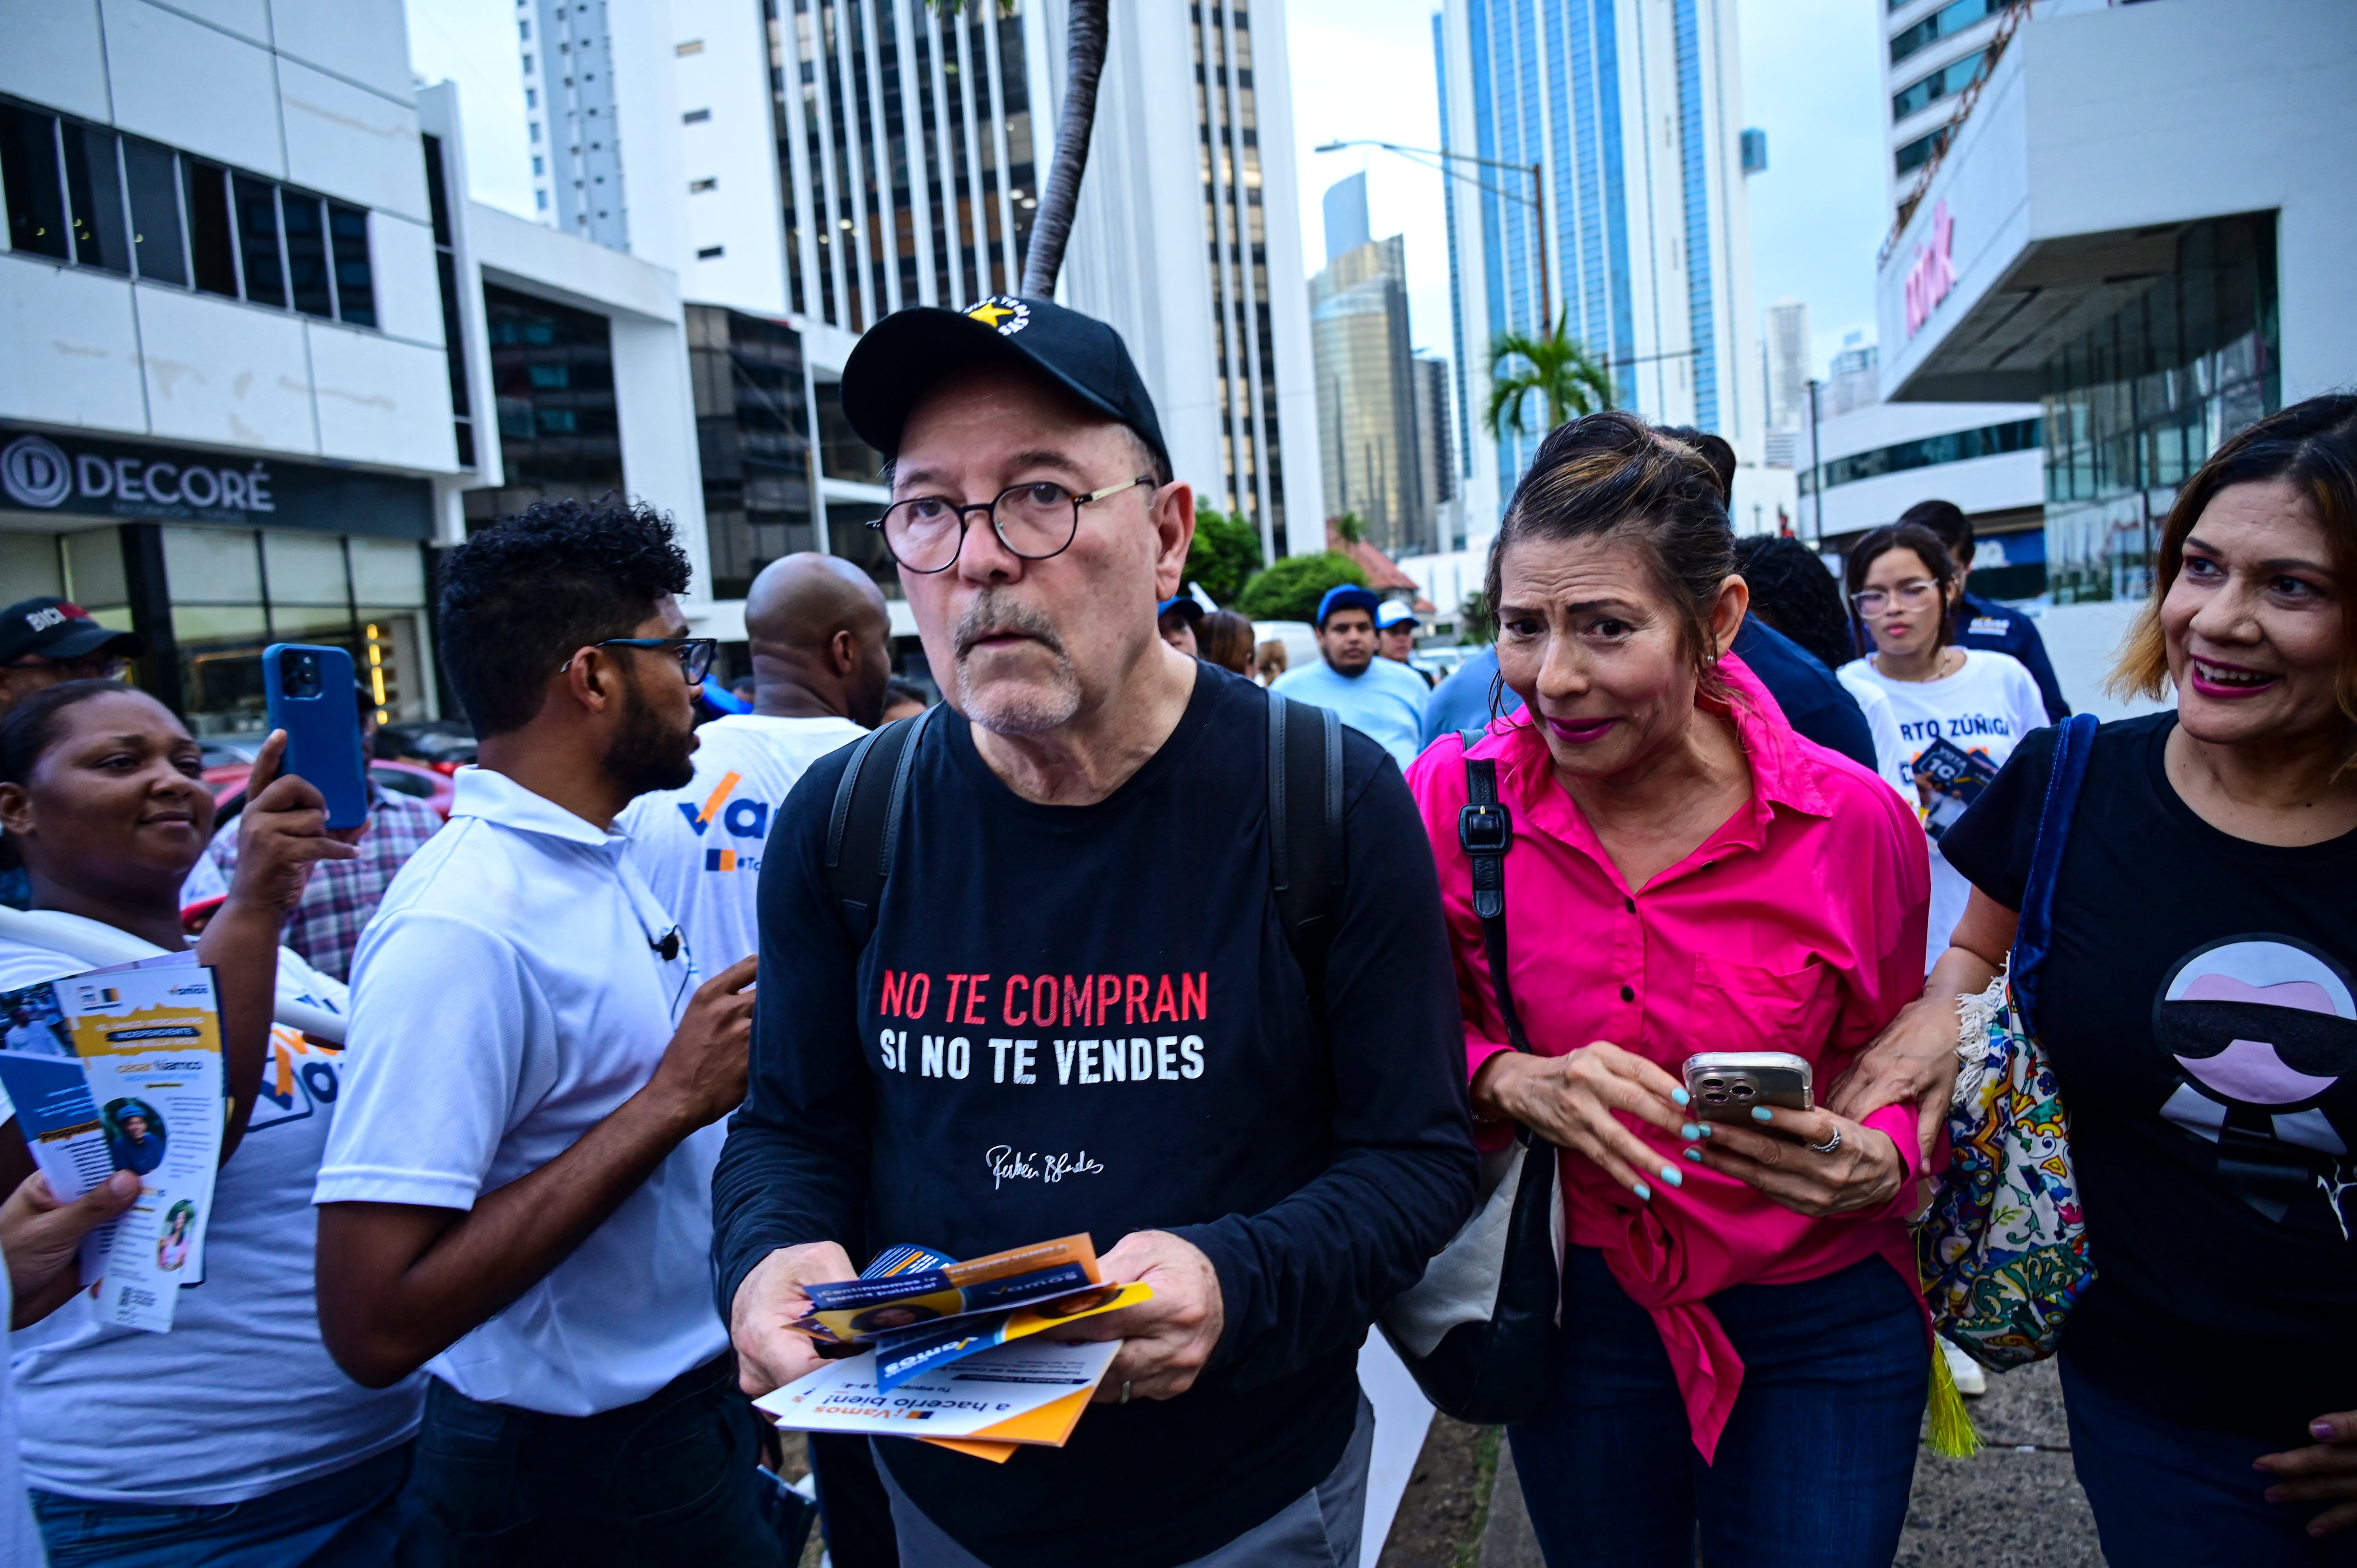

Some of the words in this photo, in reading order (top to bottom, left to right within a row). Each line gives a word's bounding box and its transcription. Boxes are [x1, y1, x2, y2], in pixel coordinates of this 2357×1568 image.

[76, 453, 275, 512] DECORÉ
[880, 969, 930, 1019] NO
[946, 974, 990, 1025] TE
[1003, 972, 1208, 1027] COMPRAN
[880, 1029, 907, 1073] SI
[922, 1035, 970, 1080] NO
[989, 1039, 1038, 1084] TE
[1053, 1035, 1205, 1085] VENDES
[986, 1144, 1040, 1190] Rubén
[826, 1292, 873, 1302] buena
[823, 1395, 888, 1406] bien!
[895, 1398, 988, 1412] hacerlo
[996, 1403, 1011, 1411] a
